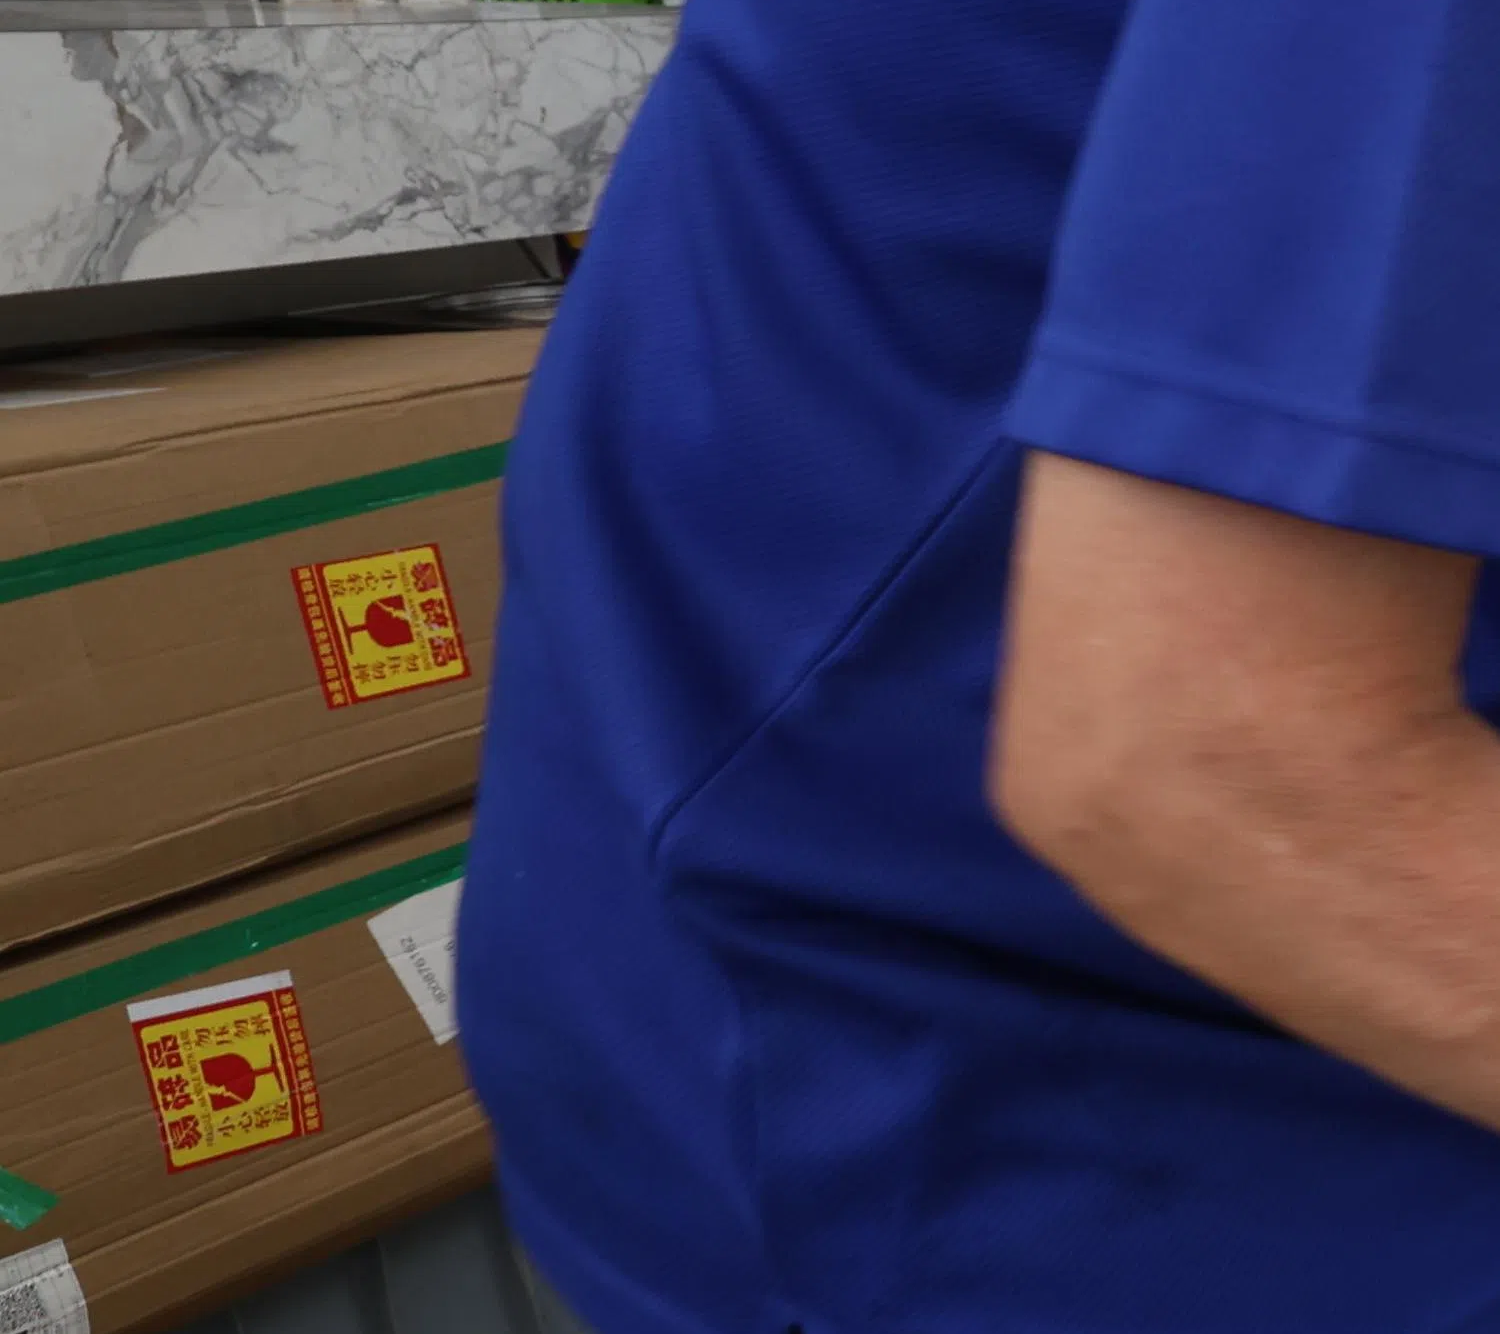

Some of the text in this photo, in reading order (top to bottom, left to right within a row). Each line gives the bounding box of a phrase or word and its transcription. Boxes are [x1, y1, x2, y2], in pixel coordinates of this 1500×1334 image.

[411, 562, 460, 667] 易碎品
[147, 1034, 202, 1150] 易碎品
